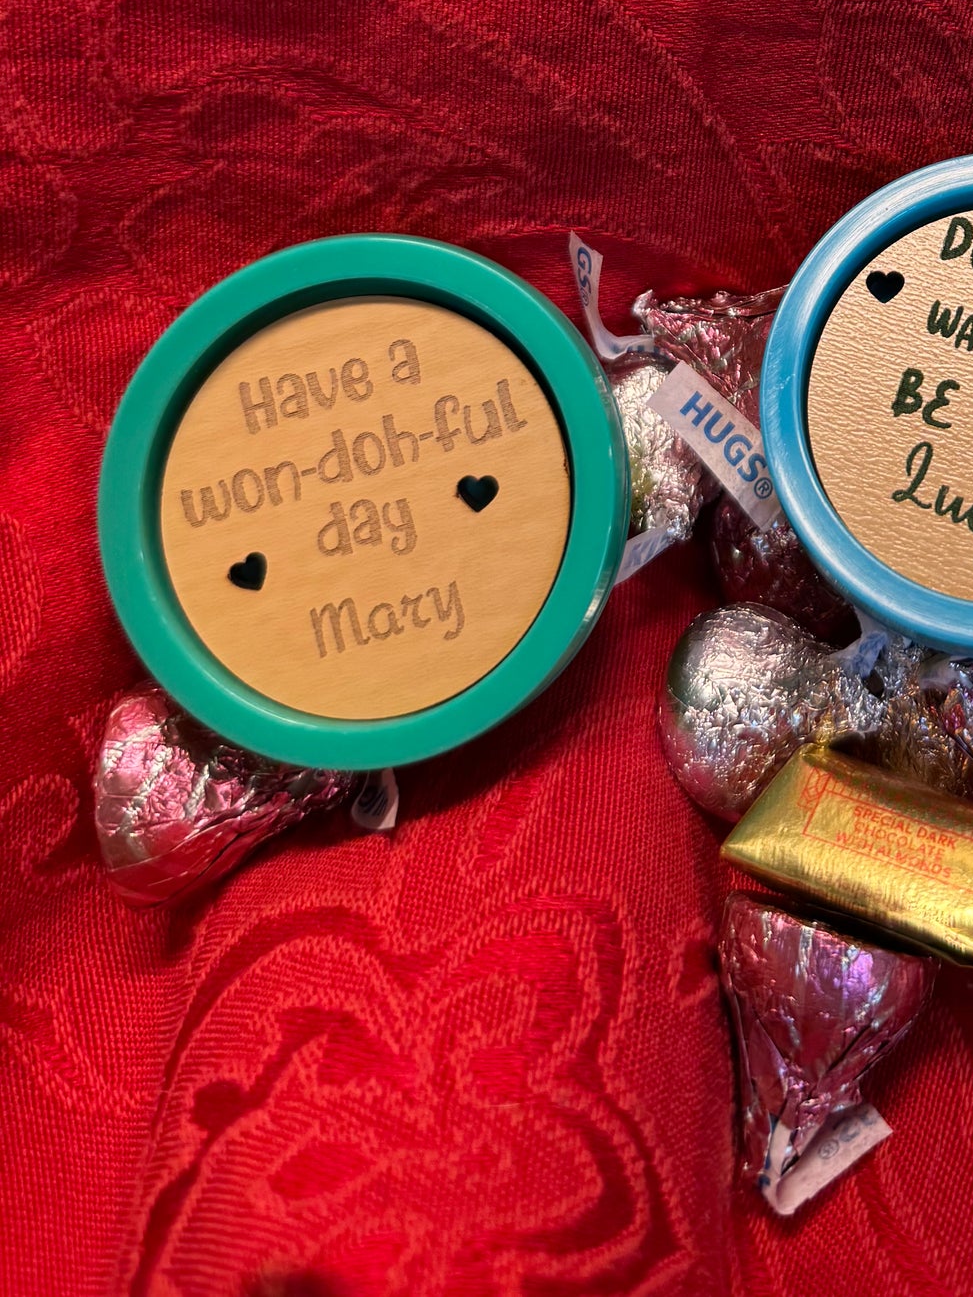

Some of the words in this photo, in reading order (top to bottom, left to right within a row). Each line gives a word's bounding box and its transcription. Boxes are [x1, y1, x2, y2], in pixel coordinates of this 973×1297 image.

[238, 357, 375, 434] Have
[389, 338, 421, 386] a
[891, 367, 960, 430] BE
[180, 377, 528, 528] won-doh-ful
[317, 496, 418, 556] day
[309, 580, 467, 658] Mary
[836, 830, 874, 853] WITH
[877, 845, 951, 879] ALMONDS
[854, 804, 912, 835] SPECIAL
[916, 826, 957, 850] DARK
[854, 820, 946, 860] CHOCOLATE
